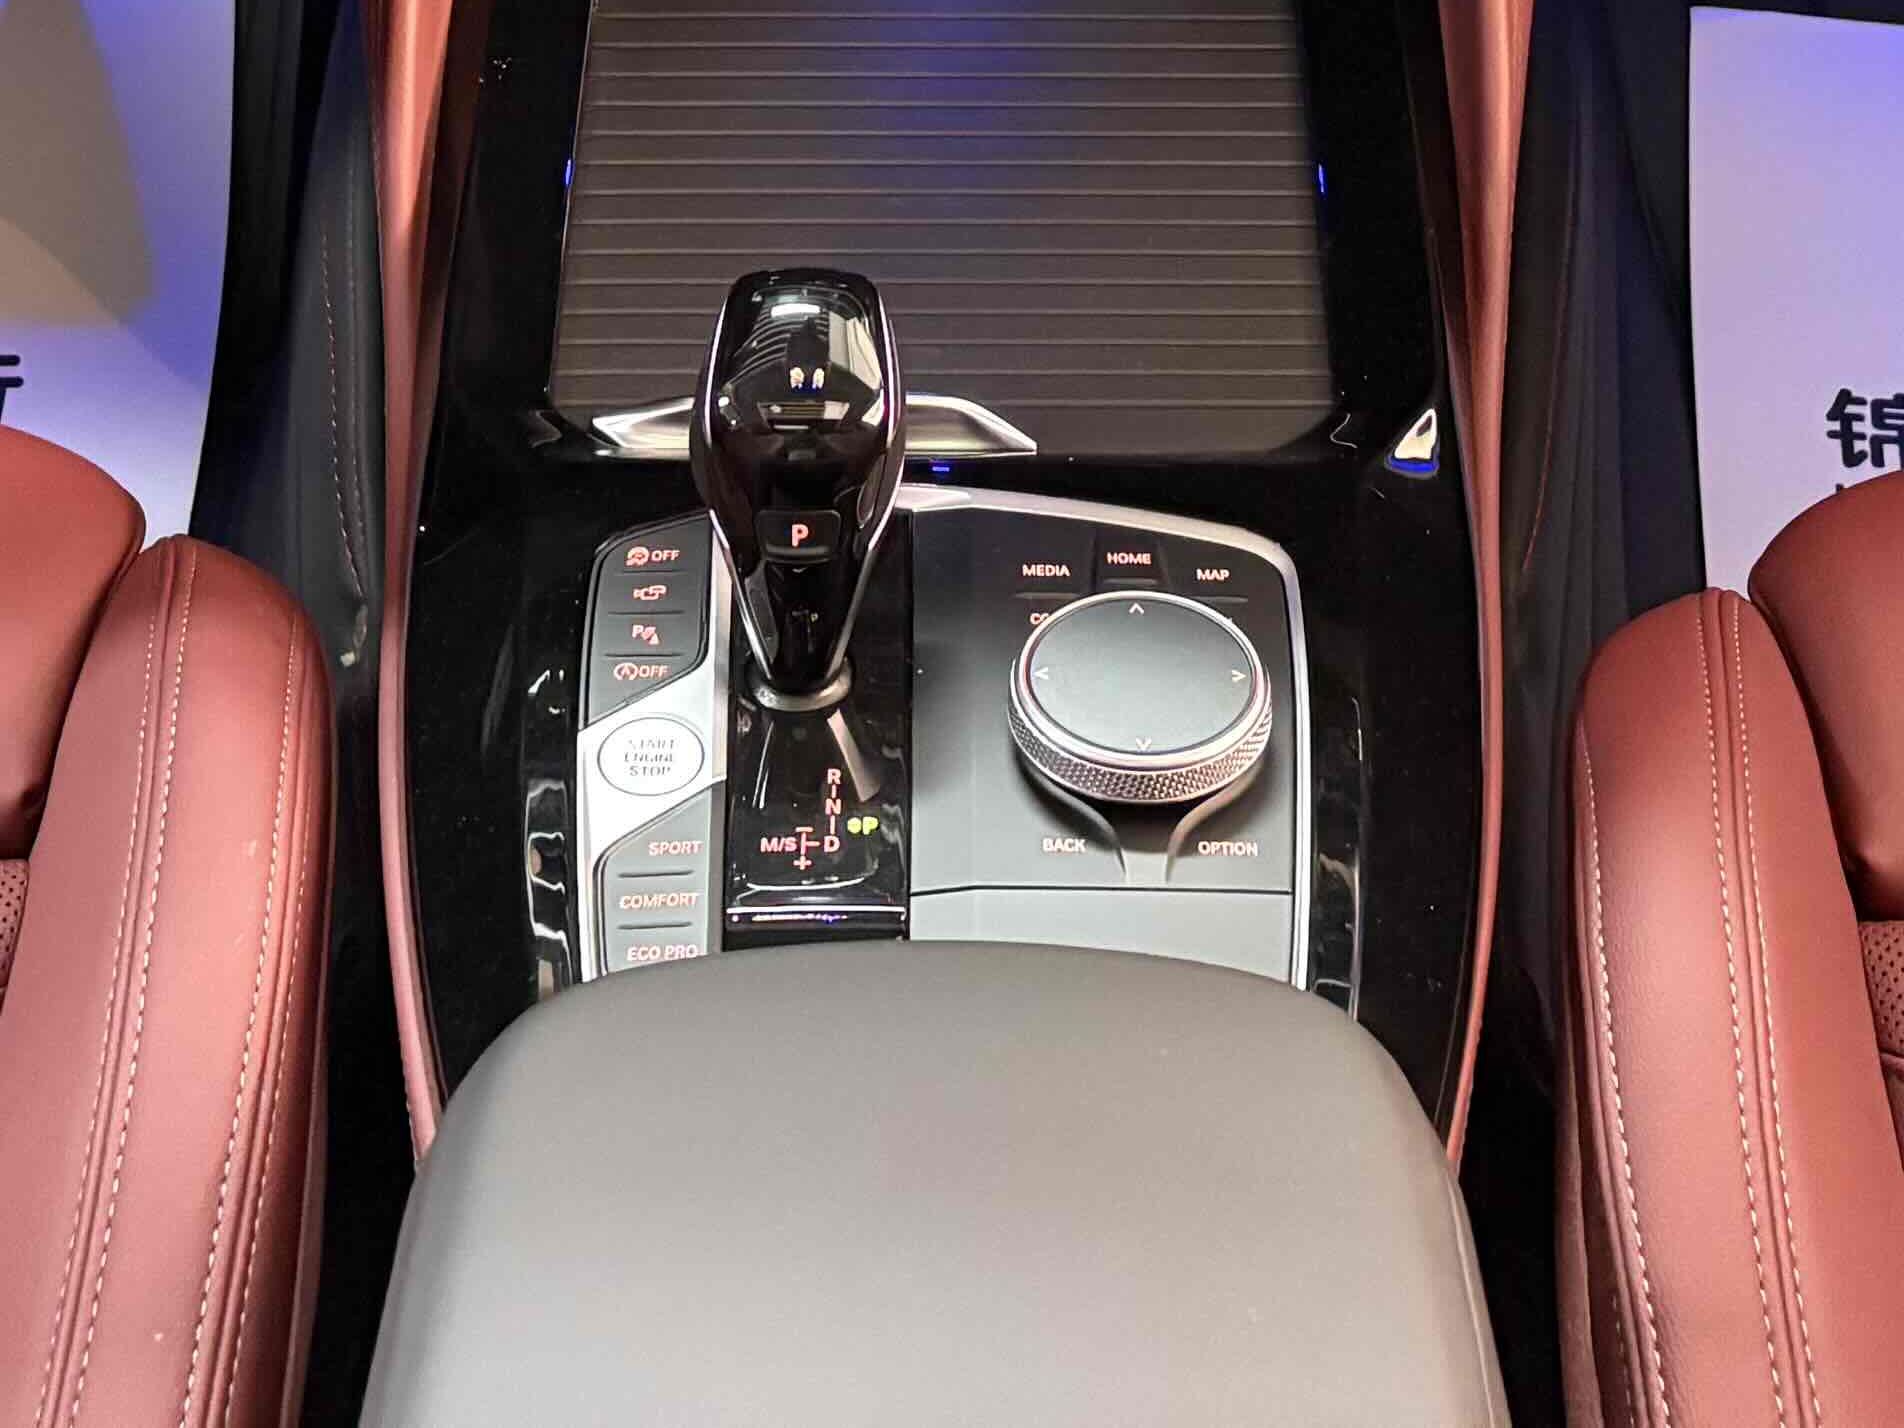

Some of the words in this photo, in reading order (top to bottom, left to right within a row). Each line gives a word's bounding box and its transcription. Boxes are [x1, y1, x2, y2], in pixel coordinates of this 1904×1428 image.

[791, 523, 809, 547] P
[651, 549, 680, 562] OFF
[1107, 552, 1152, 565] HOME
[1022, 564, 1071, 577] MEDIA
[1196, 568, 1229, 581] MAP
[639, 665, 668, 677] OFF
[827, 768, 841, 784] R
[825, 798, 841, 815] N
[648, 840, 702, 856] SPORT
[760, 837, 797, 853] M/S
[824, 835, 840, 853] D
[1042, 838, 1086, 854] BACK
[1198, 840, 1258, 857] OPTION
[619, 892, 699, 909] COMFORT
[627, 945, 660, 961] ECO
[664, 944, 698, 960] PRO
